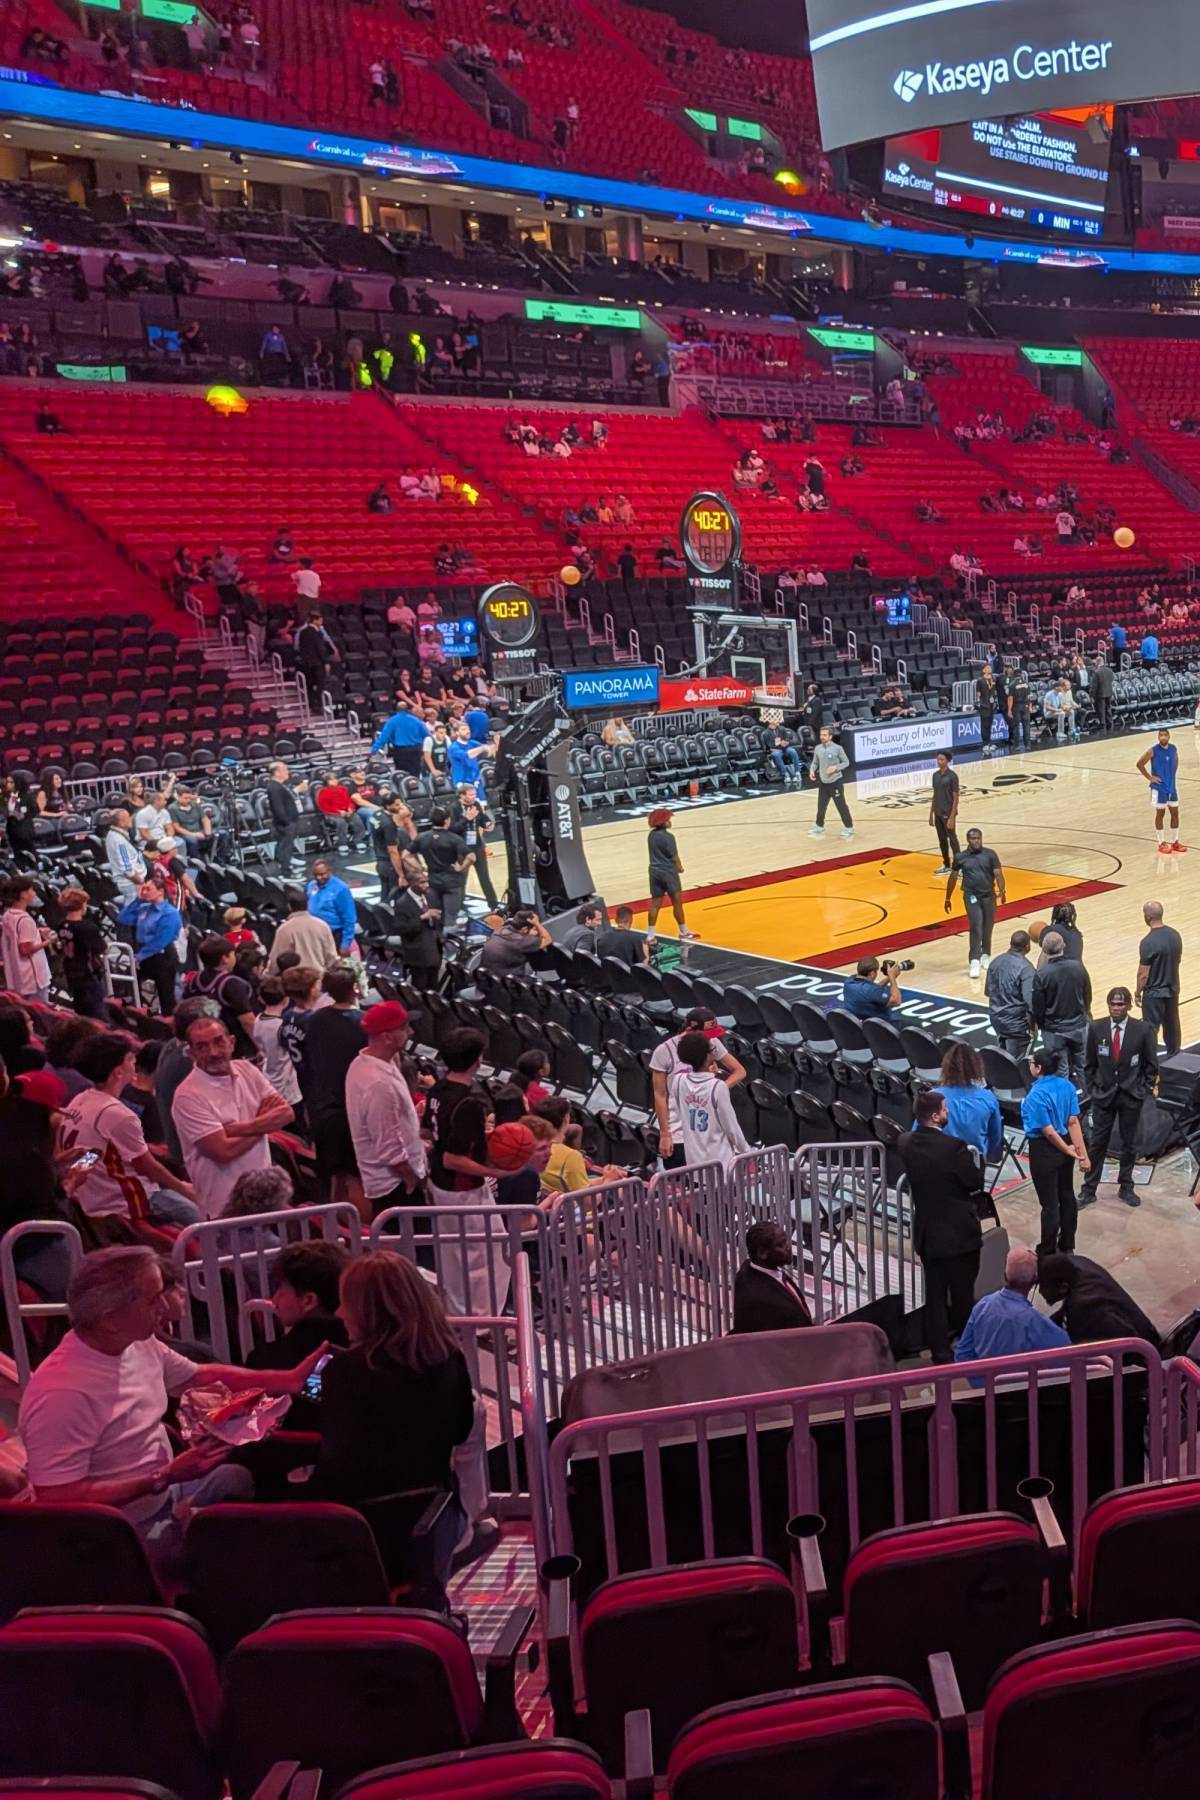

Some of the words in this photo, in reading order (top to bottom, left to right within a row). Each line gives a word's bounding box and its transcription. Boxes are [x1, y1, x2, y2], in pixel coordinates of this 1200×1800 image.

[926, 58, 1009, 95] Kaseya
[1012, 40, 1113, 80] Center
[973, 131, 985, 142] DO
[987, 133, 1002, 146] NOT
[1017, 142, 1032, 154] THE
[1032, 145, 1074, 163] ELEVATORS.
[1043, 137, 1078, 153] FASHION.
[990, 146, 1004, 158] USE
[1004, 149, 1028, 164] STAIRS
[1029, 155, 1053, 169] DOWN
[1054, 160, 1064, 172] TO
[1065, 164, 1098, 179] GROUND
[884, 169, 910, 188] Kaseya
[909, 174, 934, 191] Center
[1053, 215, 1070, 230] MIN
[694, 511, 729, 531] 40:27
[700, 578, 731, 589] TISSOT
[490, 601, 528, 618] 40:27
[505, 649, 536, 659] TISSOT
[860, 735, 878, 747] The
[880, 731, 909, 747] Luxury
[911, 729, 920, 740] of
[923, 726, 945, 738] More
[871, 741, 937, 756] PanoramaTower.com
[557, 802, 574, 840] AT&T
[689, 1108, 709, 1132] 13
